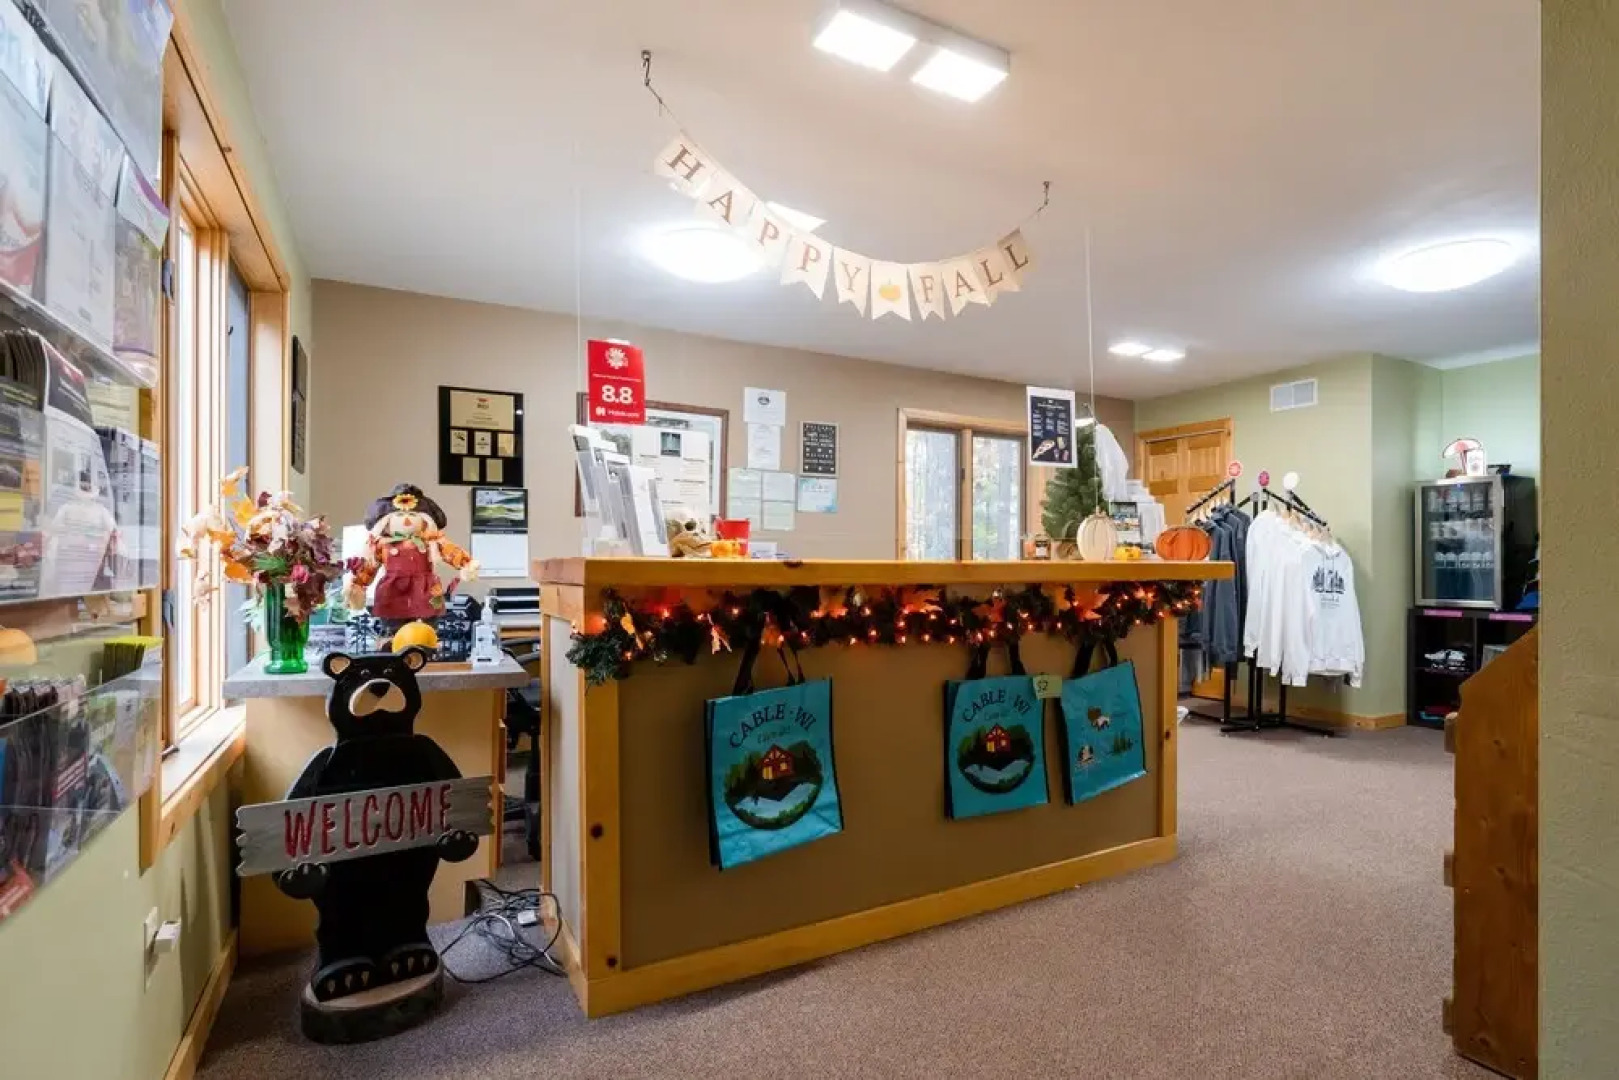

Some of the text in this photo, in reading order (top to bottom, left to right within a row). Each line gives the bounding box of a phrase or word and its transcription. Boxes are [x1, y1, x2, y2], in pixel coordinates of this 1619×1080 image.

[665, 143, 1030, 304] HAPPY FALL
[601, 384, 634, 405] 8.8
[729, 703, 786, 749] CABLE
[284, 783, 453, 860] WELCOME
